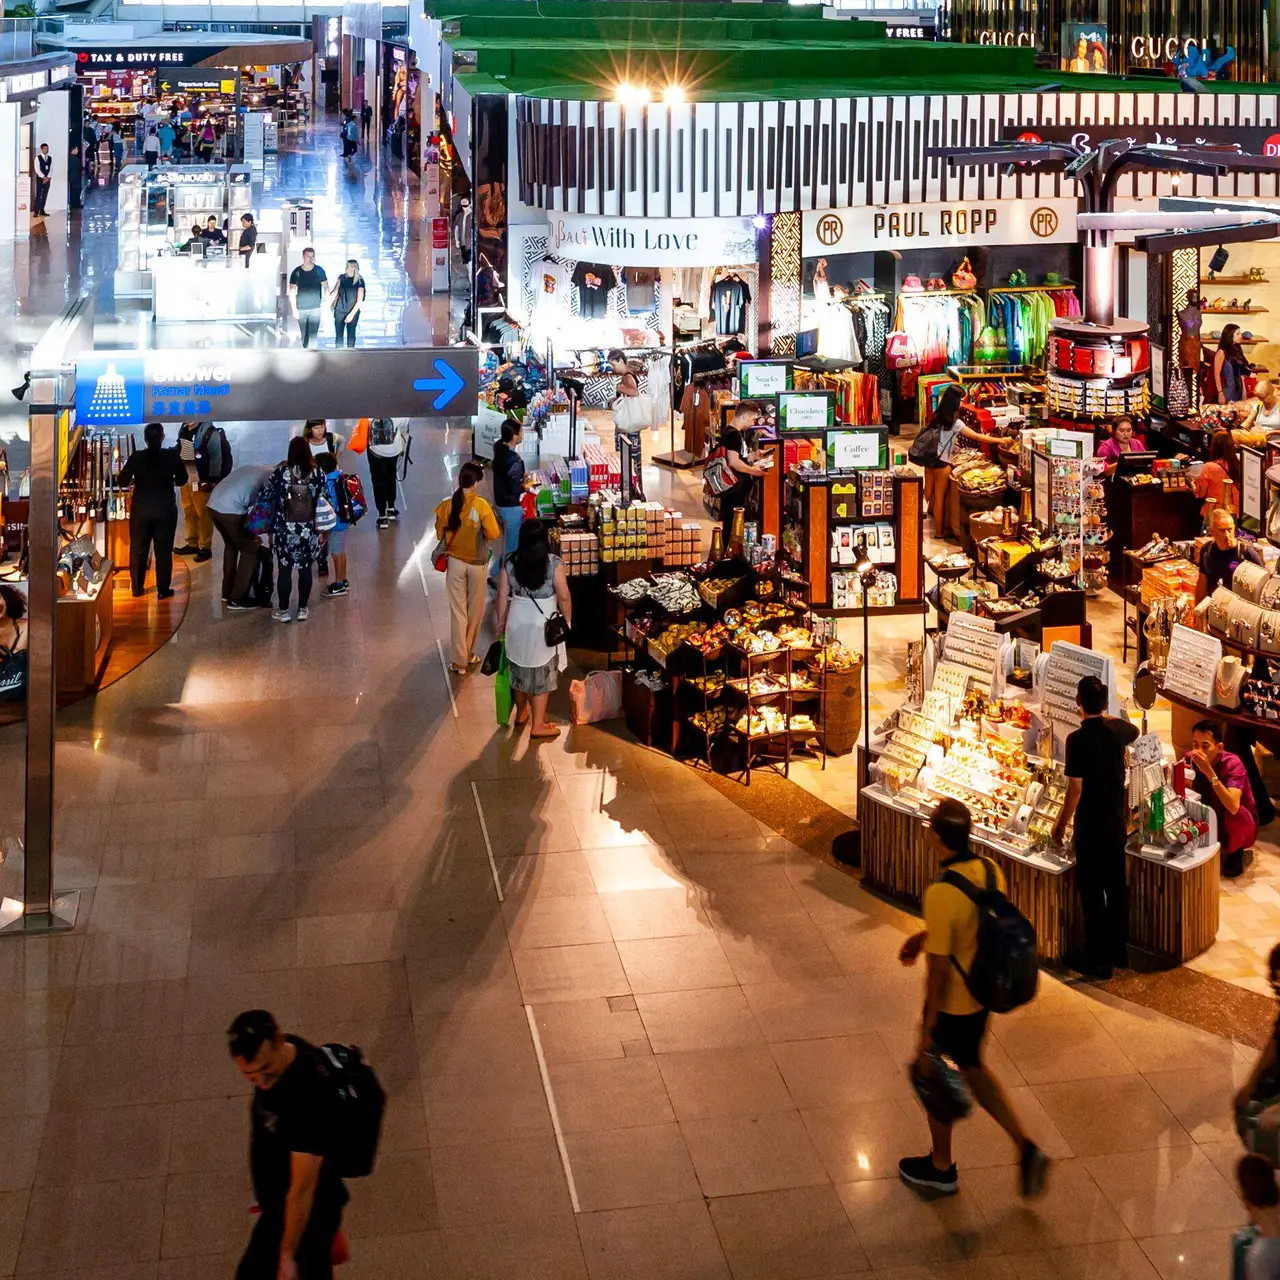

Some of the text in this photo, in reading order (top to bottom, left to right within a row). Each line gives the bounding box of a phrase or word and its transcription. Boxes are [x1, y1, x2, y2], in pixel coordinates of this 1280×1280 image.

[328, 17, 339, 56] SPA
[896, 28, 924, 38] FREE
[980, 31, 1036, 47] GUCCI
[1131, 36, 1207, 62] GUCCI
[91, 53, 184, 62] TAX & DUTY FREE
[874, 209, 997, 238] PAUL ROPP
[592, 225, 635, 249] With
[645, 228, 699, 250] Love
[152, 384, 230, 397] Kamar Mandi
[844, 444, 869, 453] Coffee
